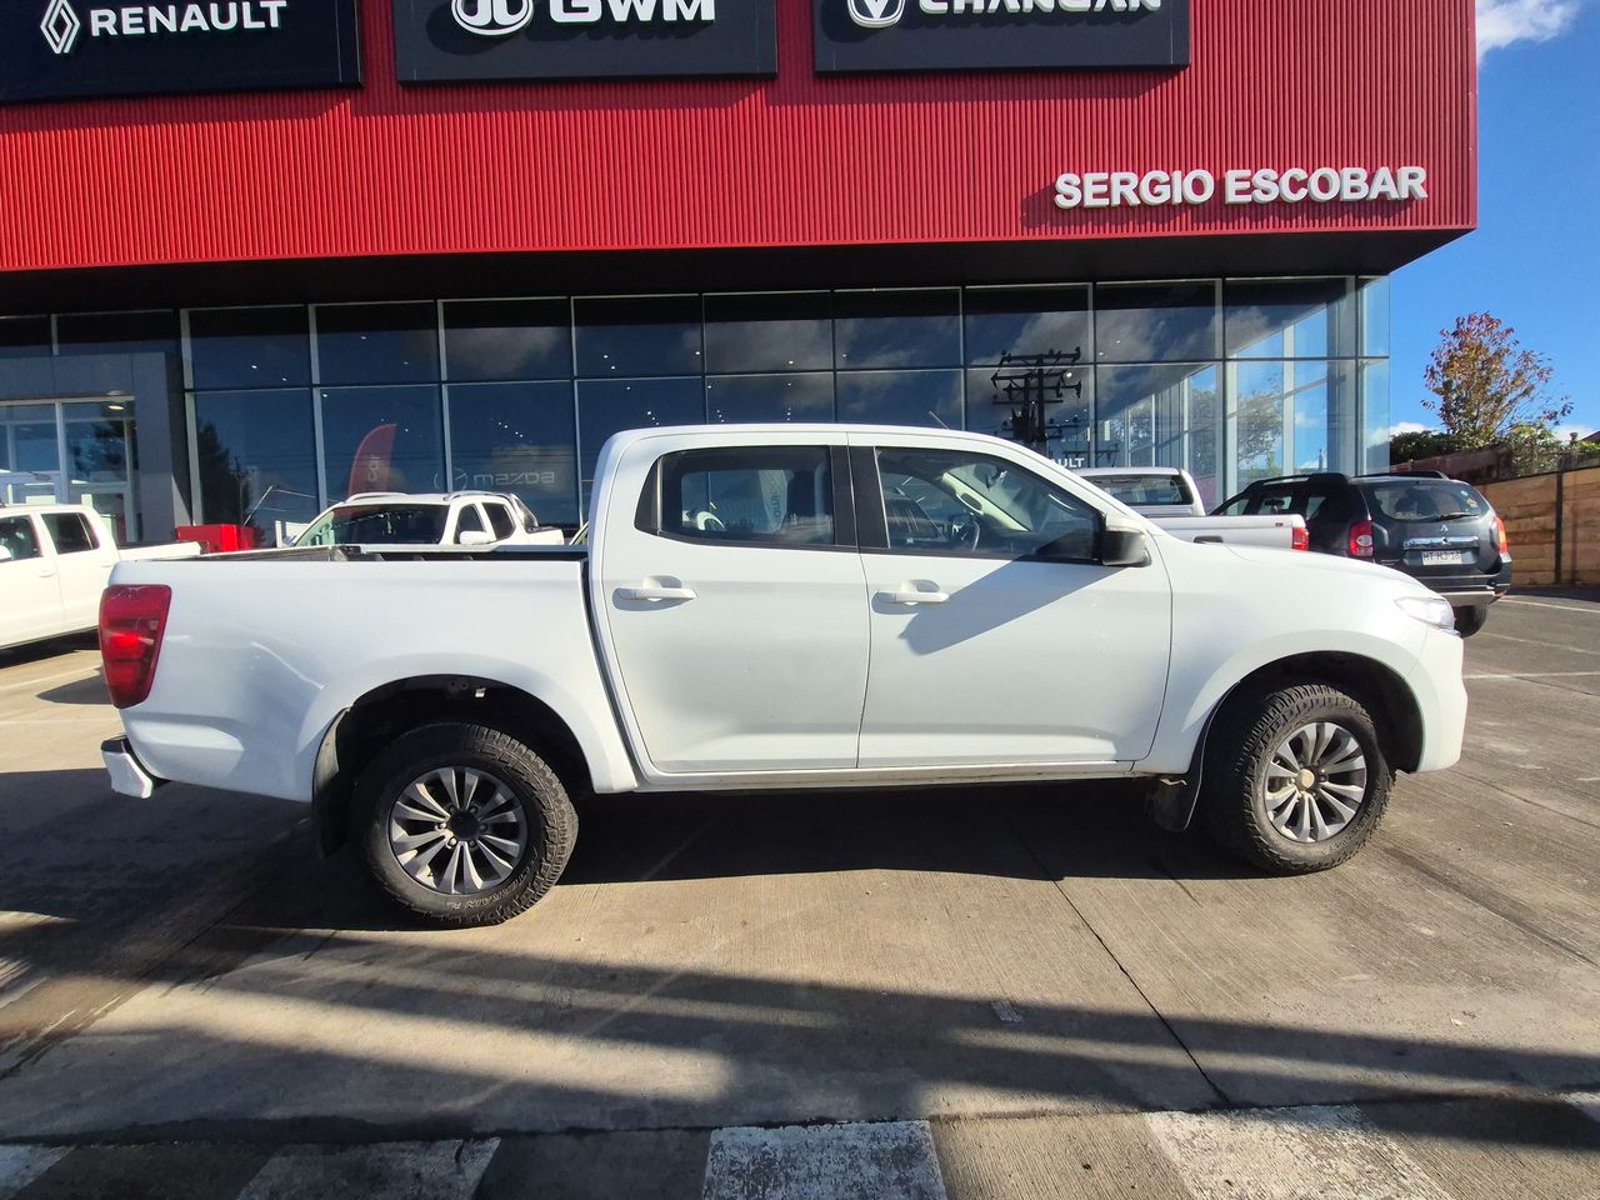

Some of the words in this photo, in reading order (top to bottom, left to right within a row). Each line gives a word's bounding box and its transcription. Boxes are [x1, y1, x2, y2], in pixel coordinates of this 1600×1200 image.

[90, 0, 287, 37] RENAULT
[1054, 169, 1215, 210] SERGIO
[1225, 166, 1428, 206] ESCOBAR
